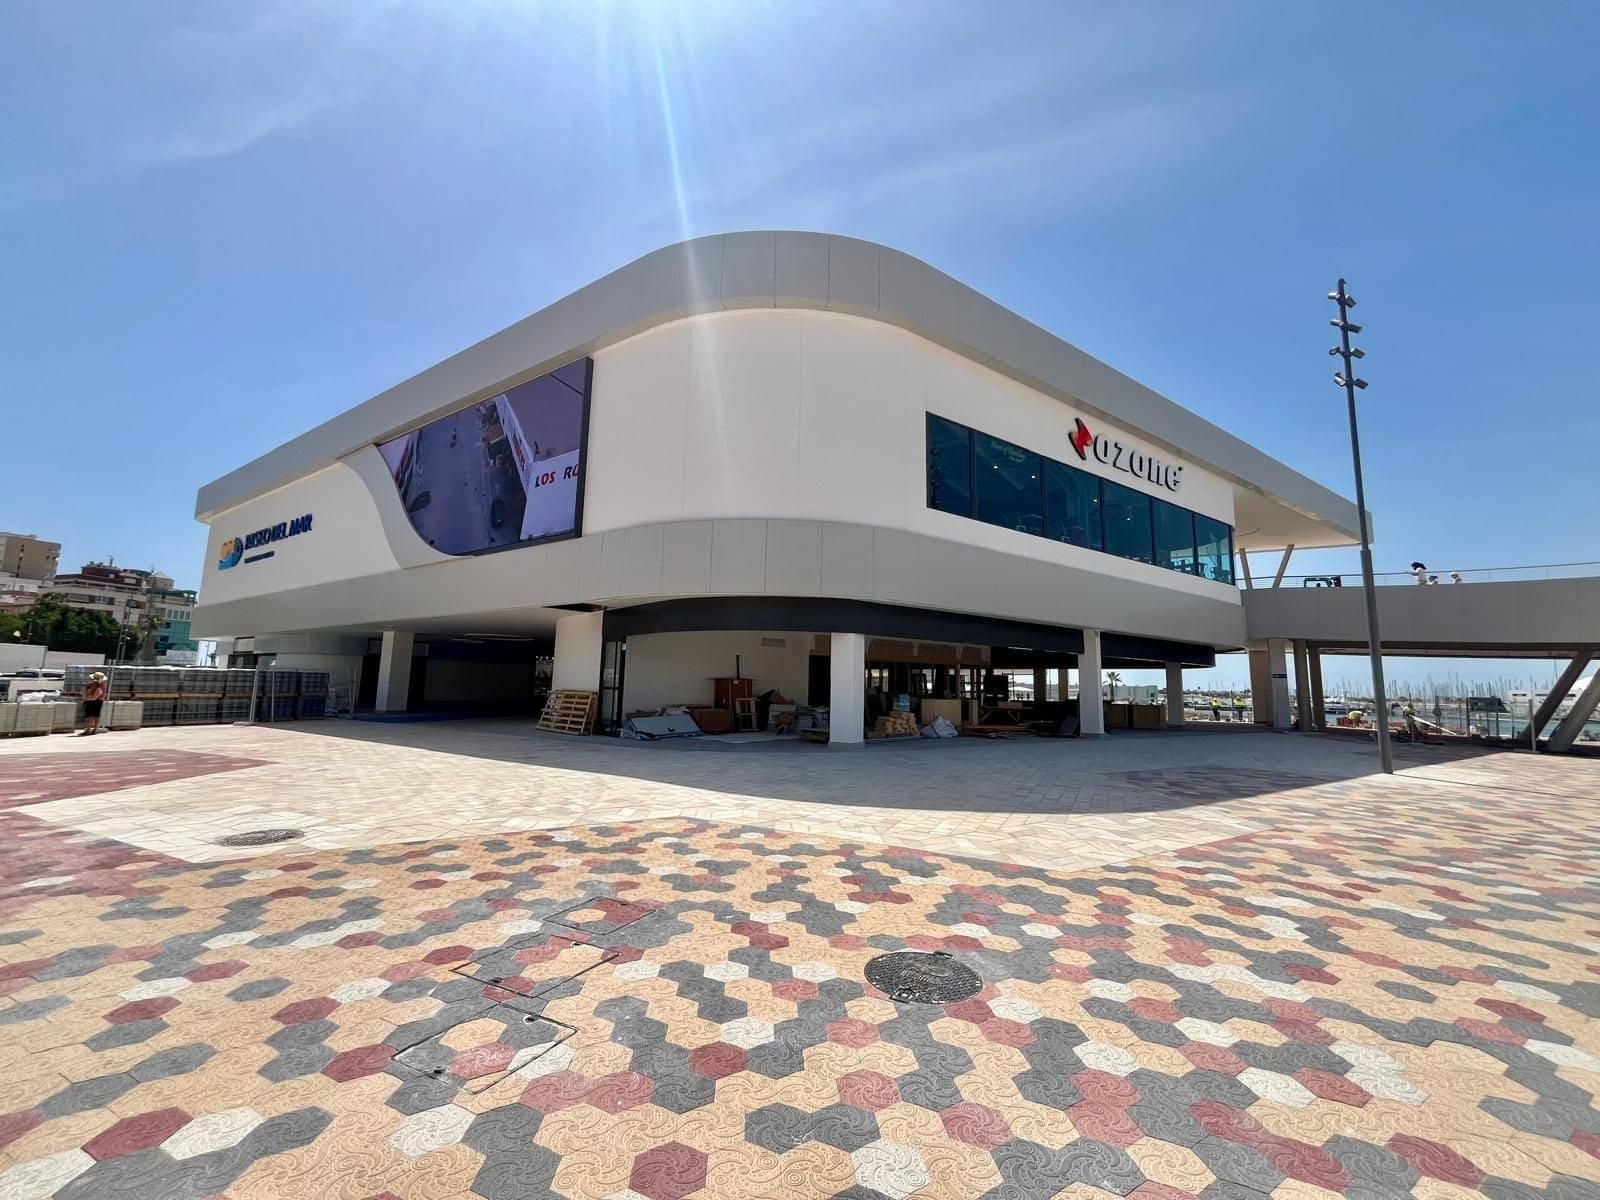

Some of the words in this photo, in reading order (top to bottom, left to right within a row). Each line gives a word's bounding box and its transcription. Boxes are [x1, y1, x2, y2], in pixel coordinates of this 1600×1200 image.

[534, 471, 557, 488] LOS
[270, 521, 289, 542] DEL
[288, 513, 313, 537] MAR
